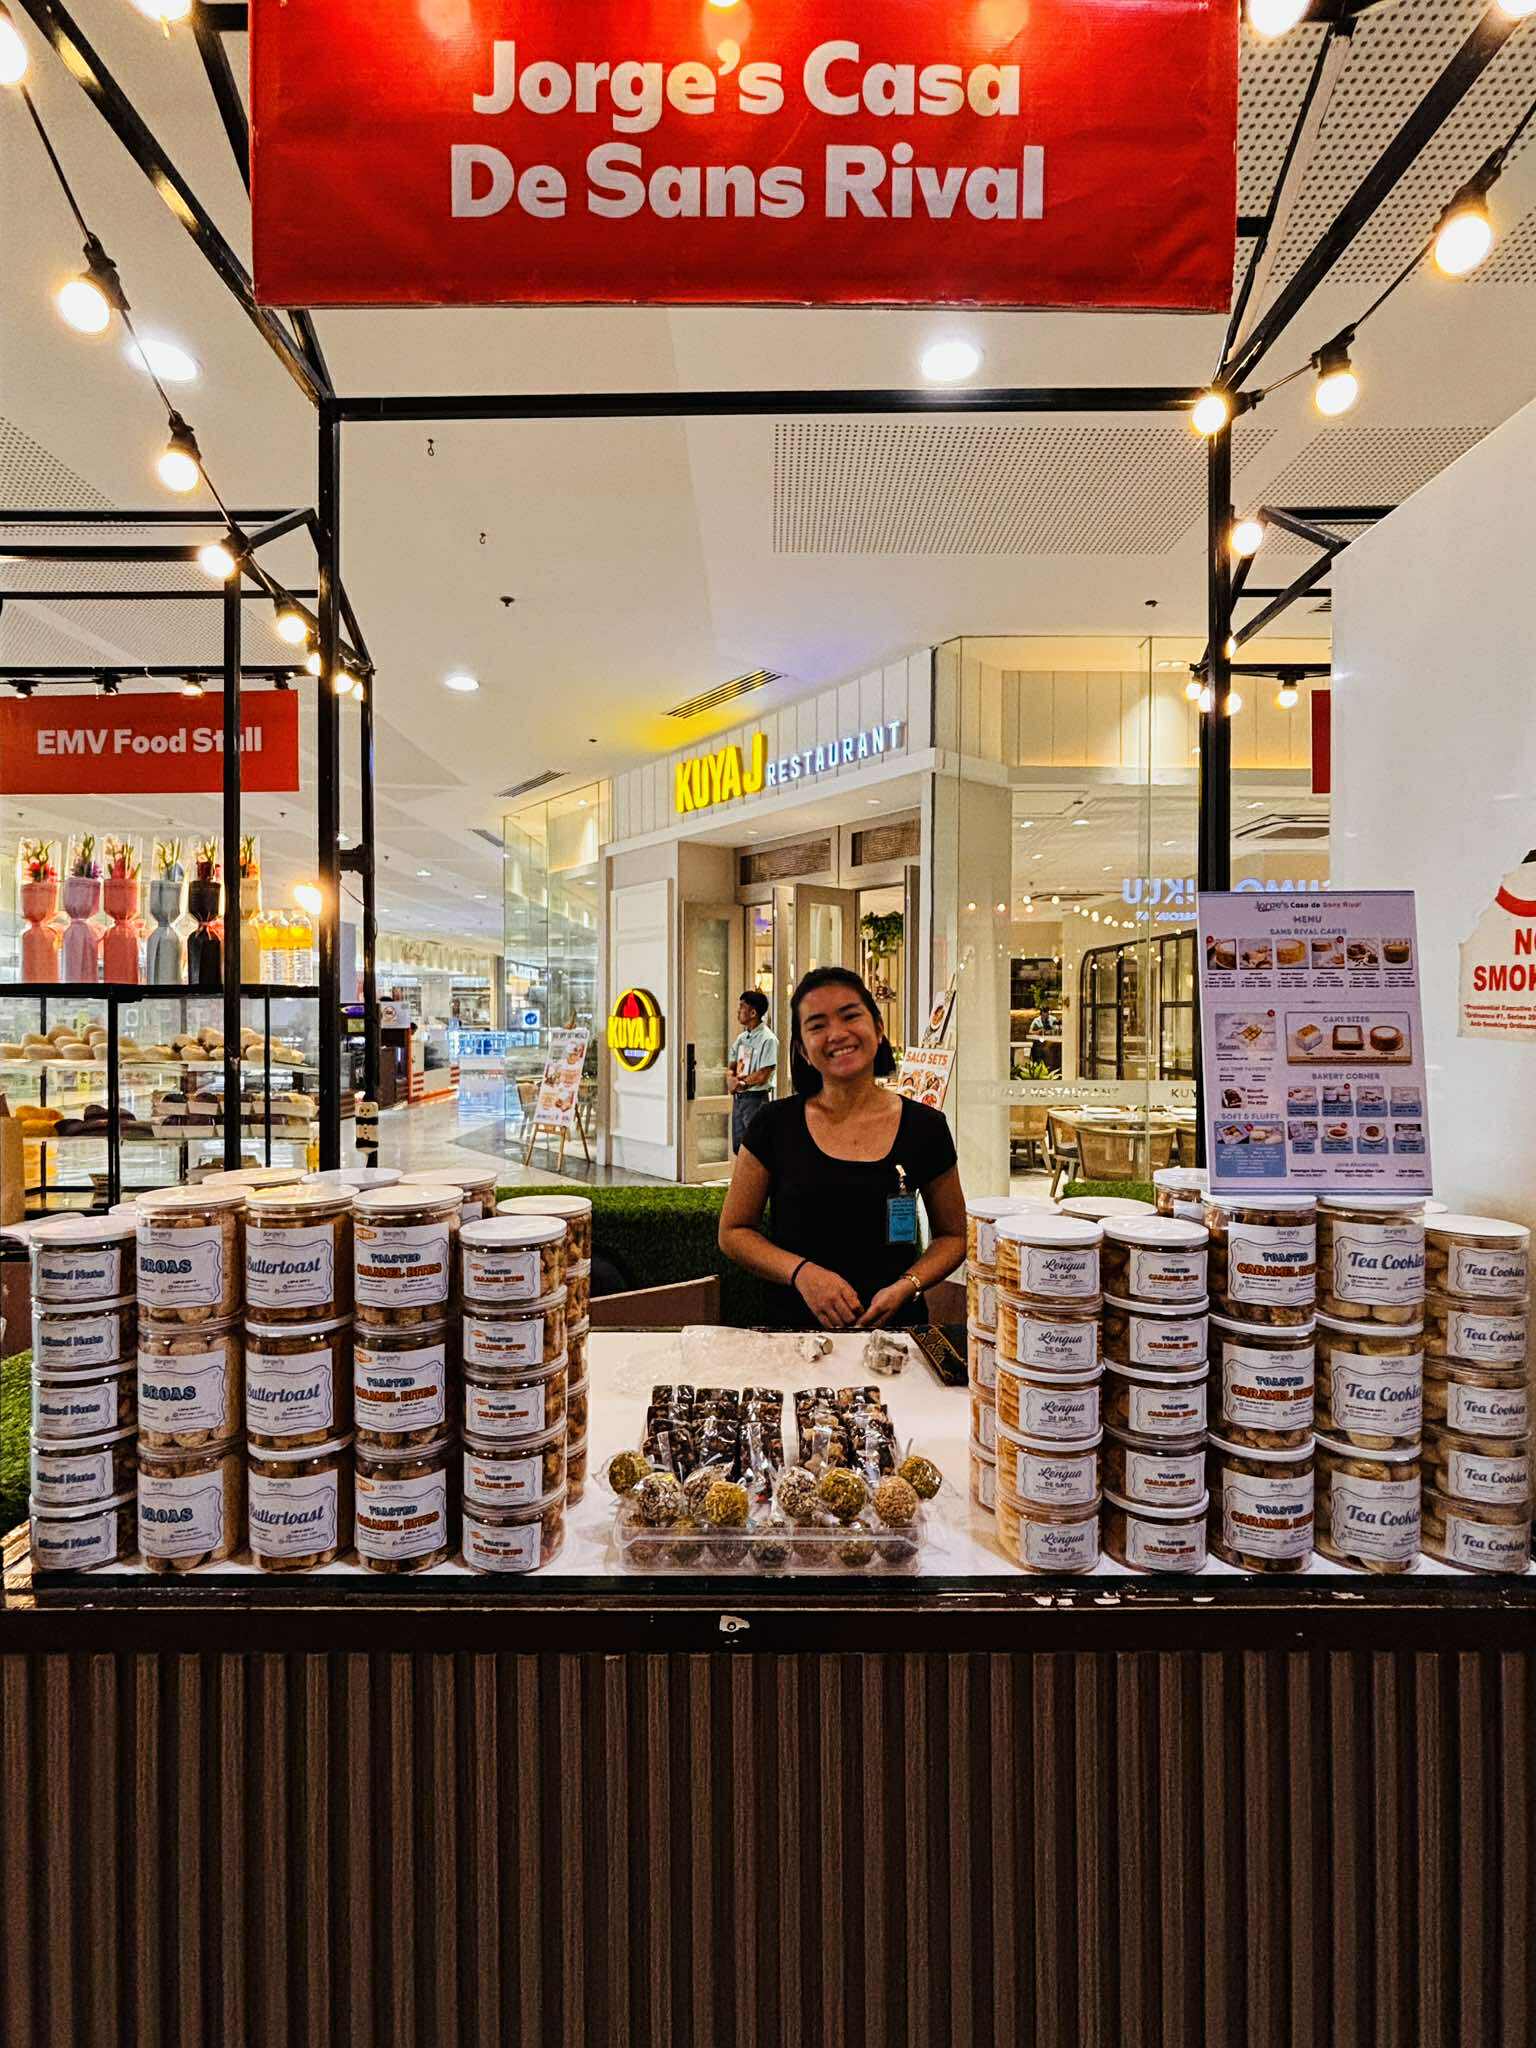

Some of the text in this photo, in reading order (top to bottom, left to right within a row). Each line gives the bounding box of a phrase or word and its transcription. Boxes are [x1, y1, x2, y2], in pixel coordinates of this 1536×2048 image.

[472, 39, 1020, 132] Jorge's Casa
[450, 142, 1044, 220] De Sans Rival
[37, 727, 262, 755] EMV Food Stll
[675, 720, 905, 813] KUYA J RESTAURANT
[1293, 915, 1322, 923] MENU
[1514, 928, 1536, 955] N
[608, 1015, 659, 1050] KUYA J
[906, 1051, 948, 1066] SALO SETS
[1042, 1258, 1086, 1271] Lengua
[1347, 1252, 1376, 1269] Tea
[1237, 1262, 1298, 1277] CARAMEL
[1464, 1263, 1487, 1276] Tea
[1038, 1332, 1083, 1345] Lengua
[1463, 1327, 1487, 1340] Tea
[1231, 1384, 1292, 1401] CARAMEL
[1345, 1383, 1376, 1401] Tea
[1041, 1400, 1085, 1414] Lengua
[1464, 1400, 1486, 1413] Tea
[1038, 1468, 1082, 1481] Lengua
[1464, 1467, 1487, 1482] Tea
[1231, 1510, 1293, 1529] CARAMEL
[1347, 1504, 1375, 1523] Tea
[1041, 1533, 1084, 1545] Lengua
[1462, 1534, 1485, 1547] Tea
